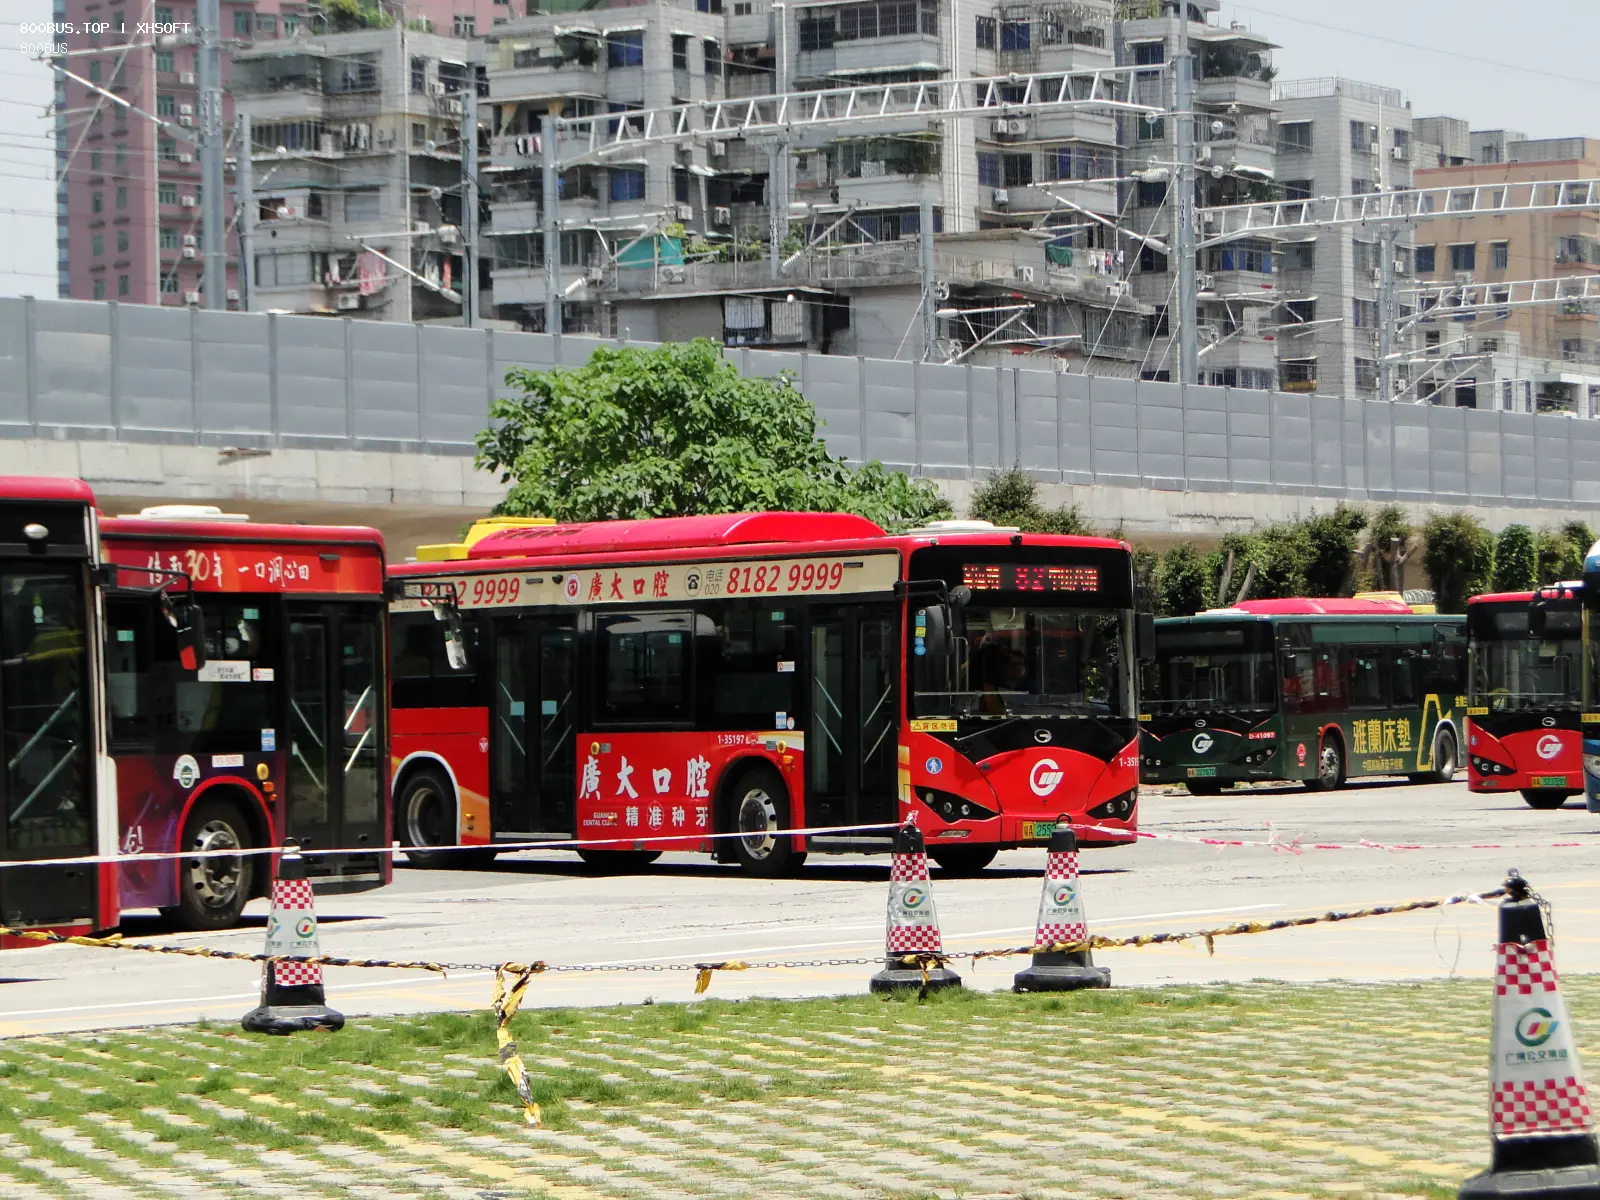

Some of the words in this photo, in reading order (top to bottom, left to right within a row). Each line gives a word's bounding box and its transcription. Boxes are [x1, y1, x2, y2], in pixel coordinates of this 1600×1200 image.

[706, 568, 724, 582] 电话
[726, 564, 782, 594] 8182
[787, 562, 843, 591] 9999
[472, 577, 520, 604] 9999
[717, 735, 745, 745] 1-35197
[579, 754, 711, 801] 廣大口腔
